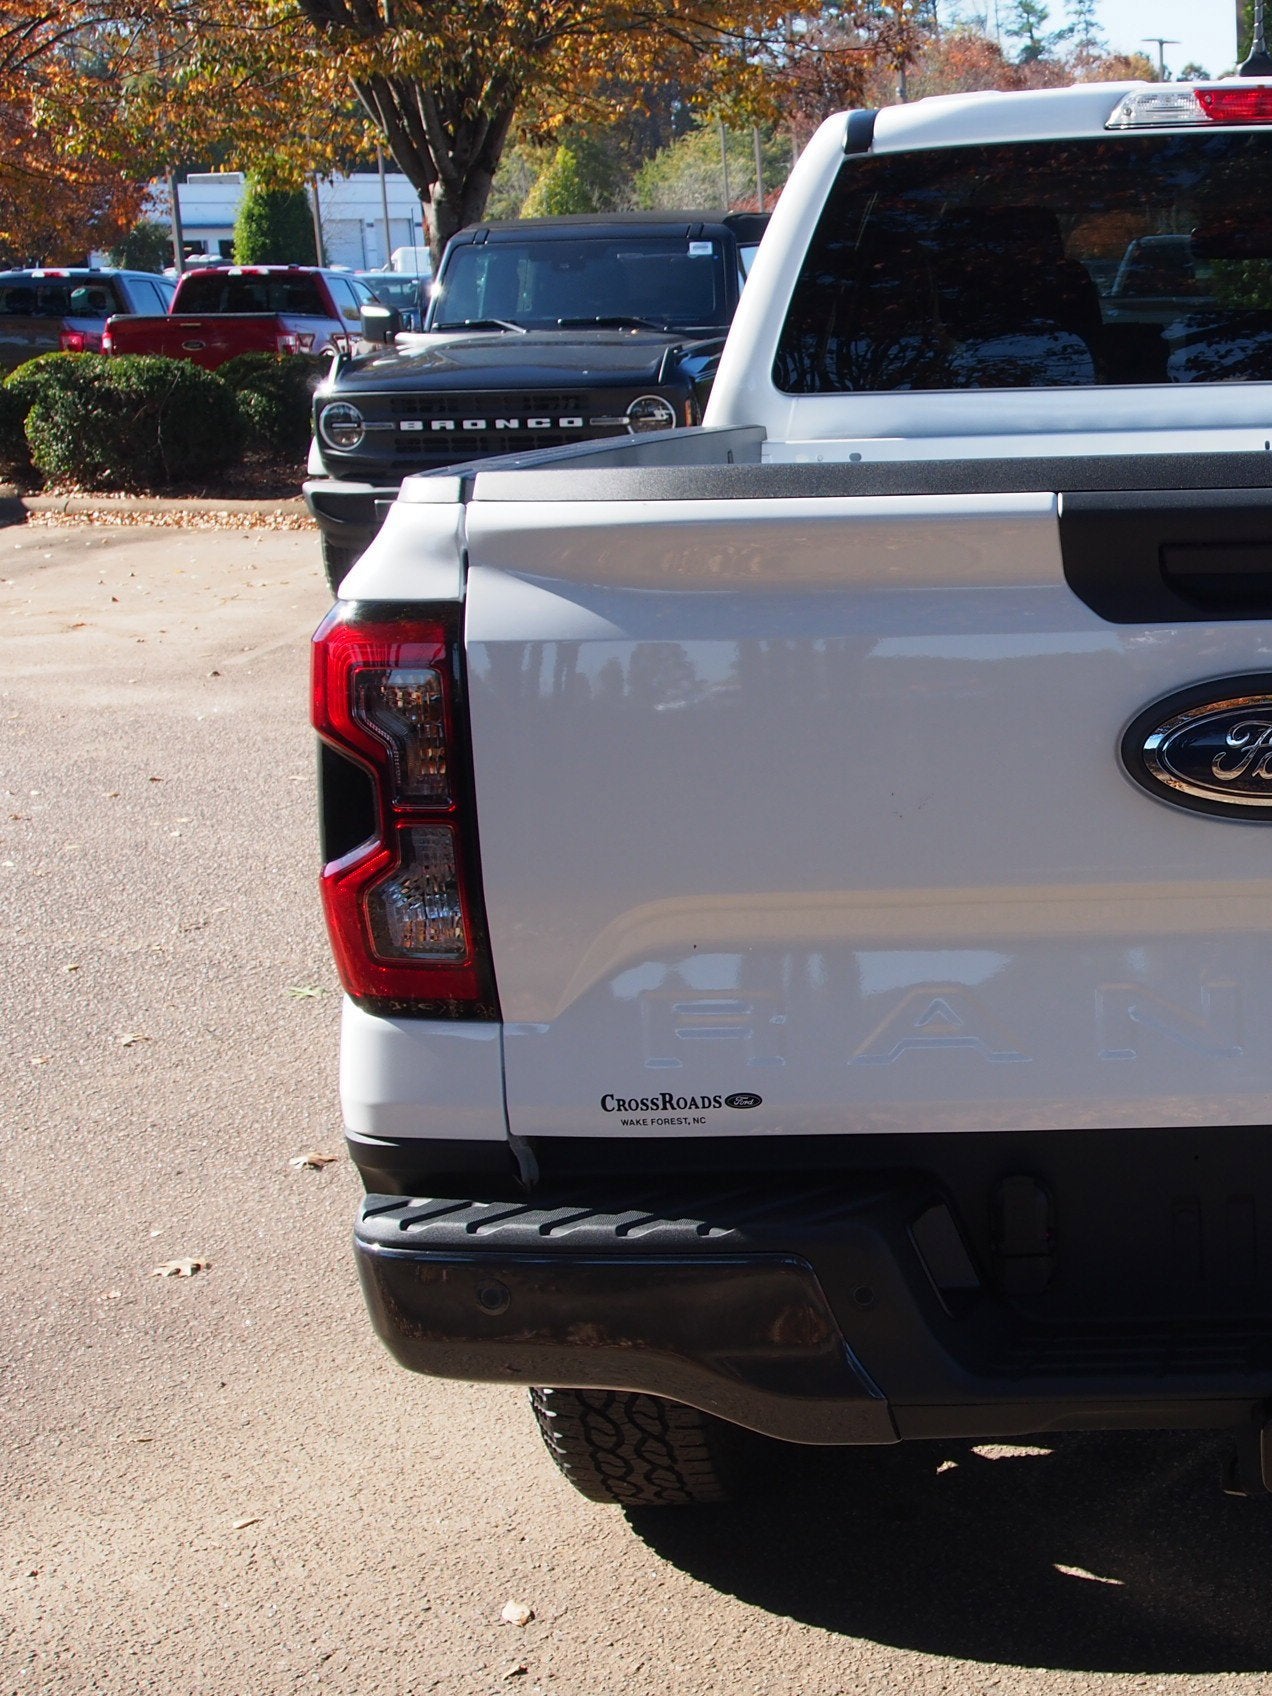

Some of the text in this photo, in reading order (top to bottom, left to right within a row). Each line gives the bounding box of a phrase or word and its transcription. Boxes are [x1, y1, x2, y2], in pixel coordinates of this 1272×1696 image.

[399, 417, 584, 431] BRONCO
[620, 1116, 706, 1126] WAKE FOREST, NC
